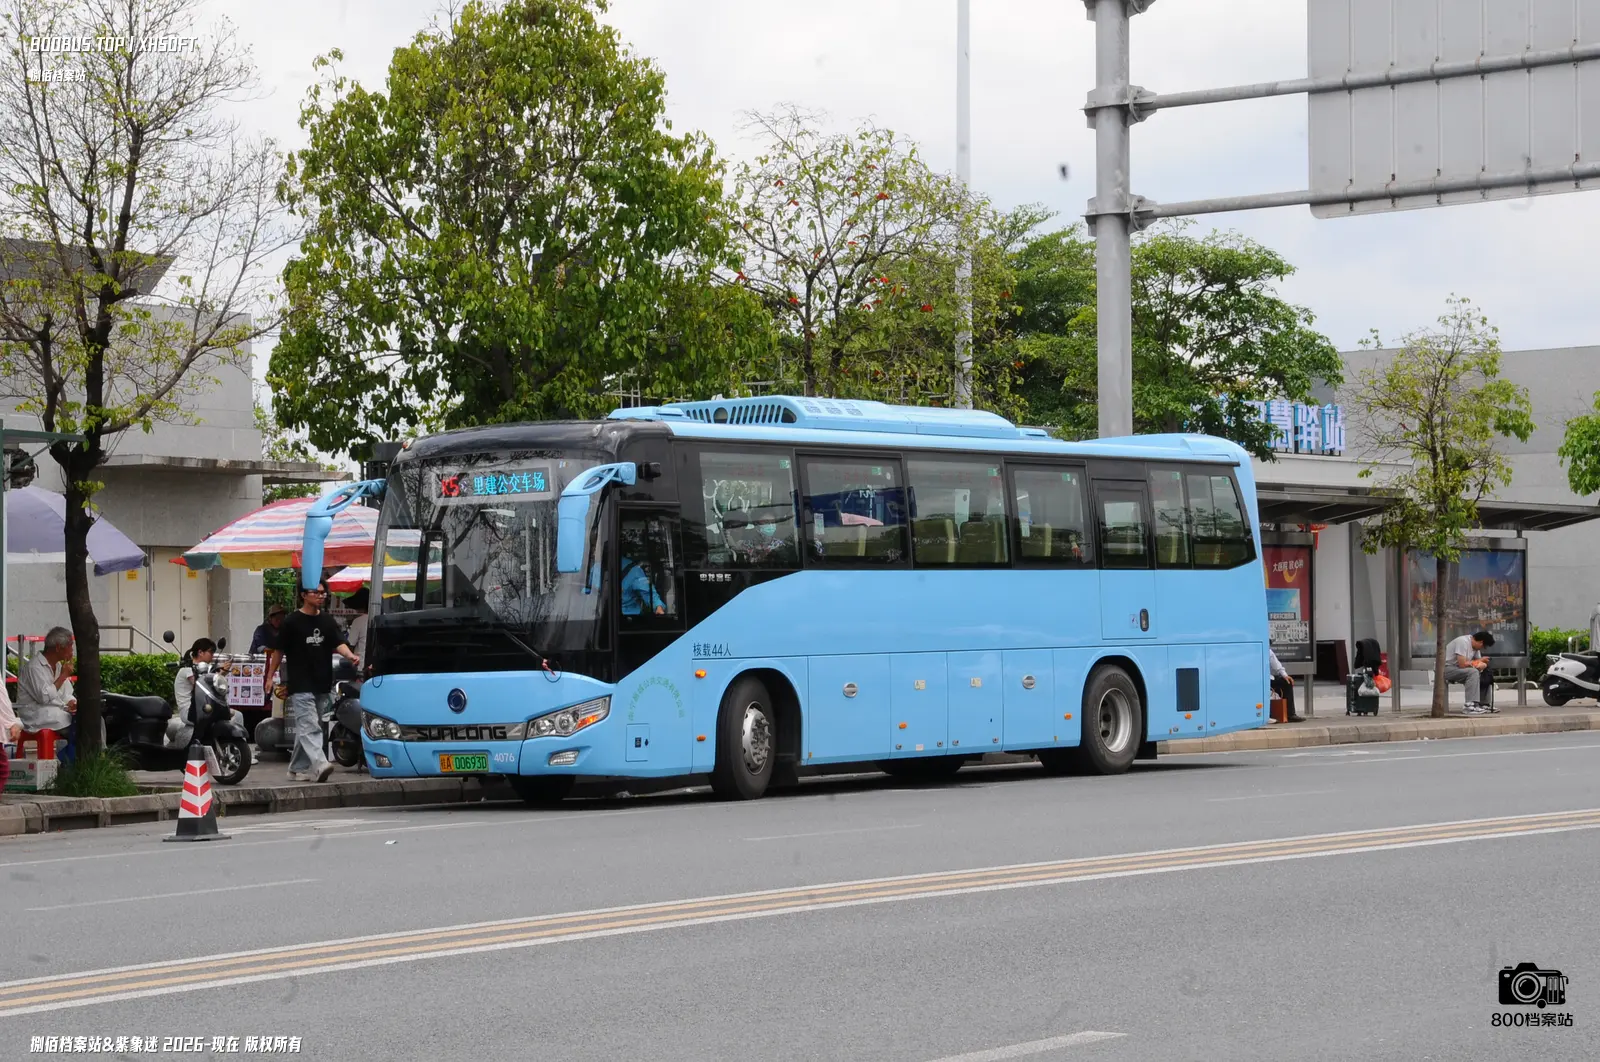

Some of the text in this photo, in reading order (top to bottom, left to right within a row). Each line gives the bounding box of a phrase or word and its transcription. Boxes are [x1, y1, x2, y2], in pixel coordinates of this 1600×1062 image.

[473, 472, 545, 495] 里建公交车场
[692, 642, 732, 657] 核载44人
[416, 726, 507, 741] SUNLONG
[494, 752, 515, 763] 4076
